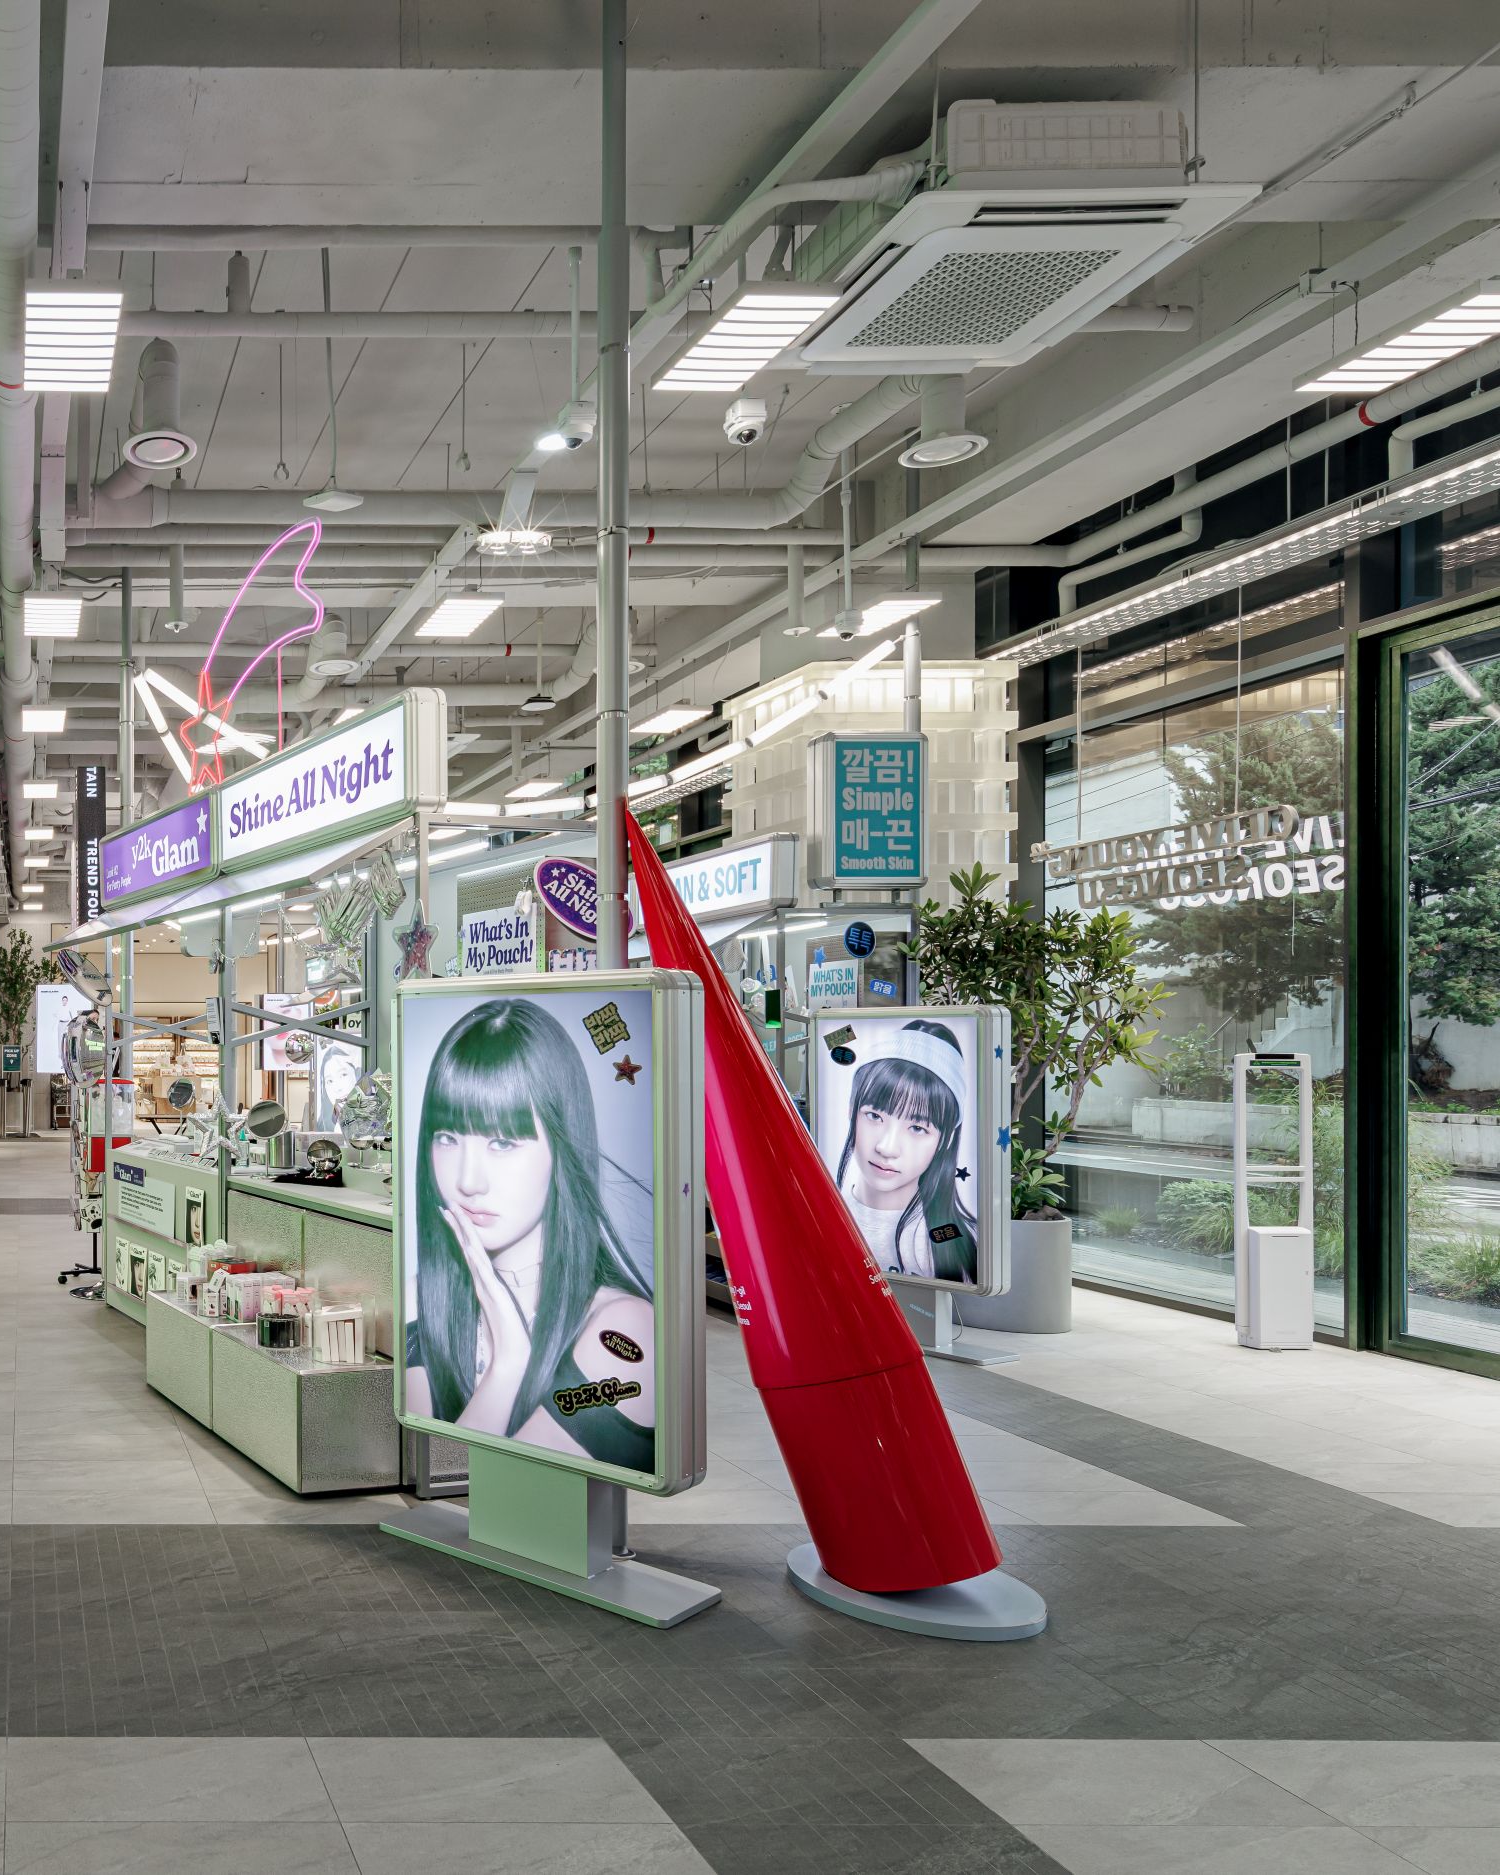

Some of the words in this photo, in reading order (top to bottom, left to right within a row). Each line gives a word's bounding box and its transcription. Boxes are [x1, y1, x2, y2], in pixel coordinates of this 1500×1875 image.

[842, 748, 914, 783] 깔끔!
[86, 766, 98, 798] TAIN
[229, 793, 283, 839] Shine
[286, 768, 317, 816] All
[320, 738, 394, 804] Night
[842, 787, 914, 816] Simple
[842, 818, 914, 851] 매-끈
[87, 838, 98, 885] TREND
[131, 833, 152, 870] y2k
[151, 834, 200, 877] Glam
[841, 855, 886, 870] Smooth
[888, 855, 914, 871] Skin
[698, 870, 710, 901] &
[714, 857, 762, 898] SOFT
[88, 889, 98, 921] FOU
[543, 880, 571, 902] All
[566, 894, 597, 925] Nig
[469, 917, 513, 945] What's
[515, 916, 530, 938] In
[466, 946, 486, 973] My
[487, 939, 534, 967] Pouch!
[810, 984, 823, 998] MY
[824, 981, 856, 996] POUCH!
[813, 968, 843, 983] WHAT'S
[844, 967, 854, 981] IN
[603, 1338, 615, 1349] All
[615, 1344, 637, 1360] Night
[611, 1334, 633, 1351] Shine
[600, 1380, 638, 1403] Glam
